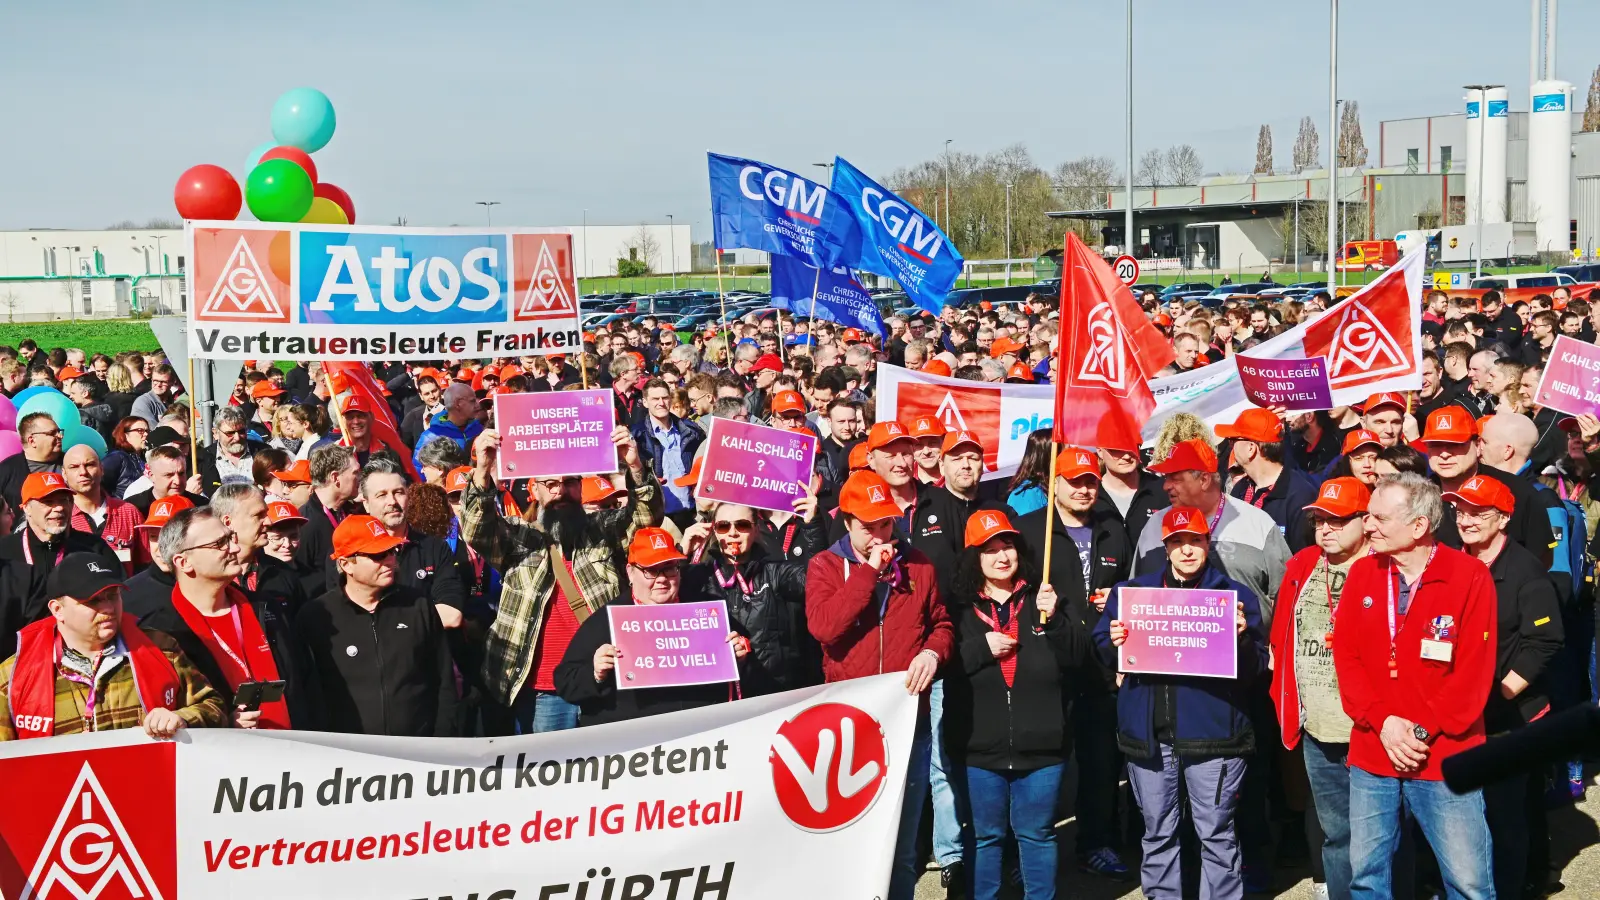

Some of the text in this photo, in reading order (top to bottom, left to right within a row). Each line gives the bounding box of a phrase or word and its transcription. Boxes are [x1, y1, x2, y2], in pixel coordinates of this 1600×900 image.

[739, 166, 827, 219] CGM
[862, 187, 944, 260] CGM
[1119, 264, 1134, 279] 20
[196, 327, 580, 354] Vertrauensleute Franken
[1242, 365, 1320, 379] 46 KOLLEGEN
[1267, 382, 1295, 391] SIND
[1592, 376, 1599, 387] ?
[1254, 390, 1317, 403] 46 ZU VIEL!
[1551, 380, 1581, 400] NEIN,
[531, 407, 579, 420] UNSERE
[508, 420, 604, 437] ARBEITSPLÄTZE
[514, 436, 599, 452] BLEIBEN HIER!
[721, 435, 803, 462] KAHLSCHLAG
[757, 459, 765, 472] ?
[714, 469, 799, 496] NEIN, DANKE!
[1131, 604, 1224, 618] STELLENABBAU
[621, 617, 719, 633] 46 KOLLEGEN
[1129, 620, 1225, 633] TROTZ REKORD-
[655, 637, 690, 650] SIND
[1148, 636, 1208, 649] ERGEBNIS
[634, 653, 717, 669] 46 ZU VIEL!
[1174, 652, 1182, 663] ?
[15, 714, 53, 733] GEBT
[774, 717, 881, 814] VL
[213, 738, 729, 814] Nah dran und kompetent
[204, 790, 744, 873] Vertrauensleute der IG Metall
